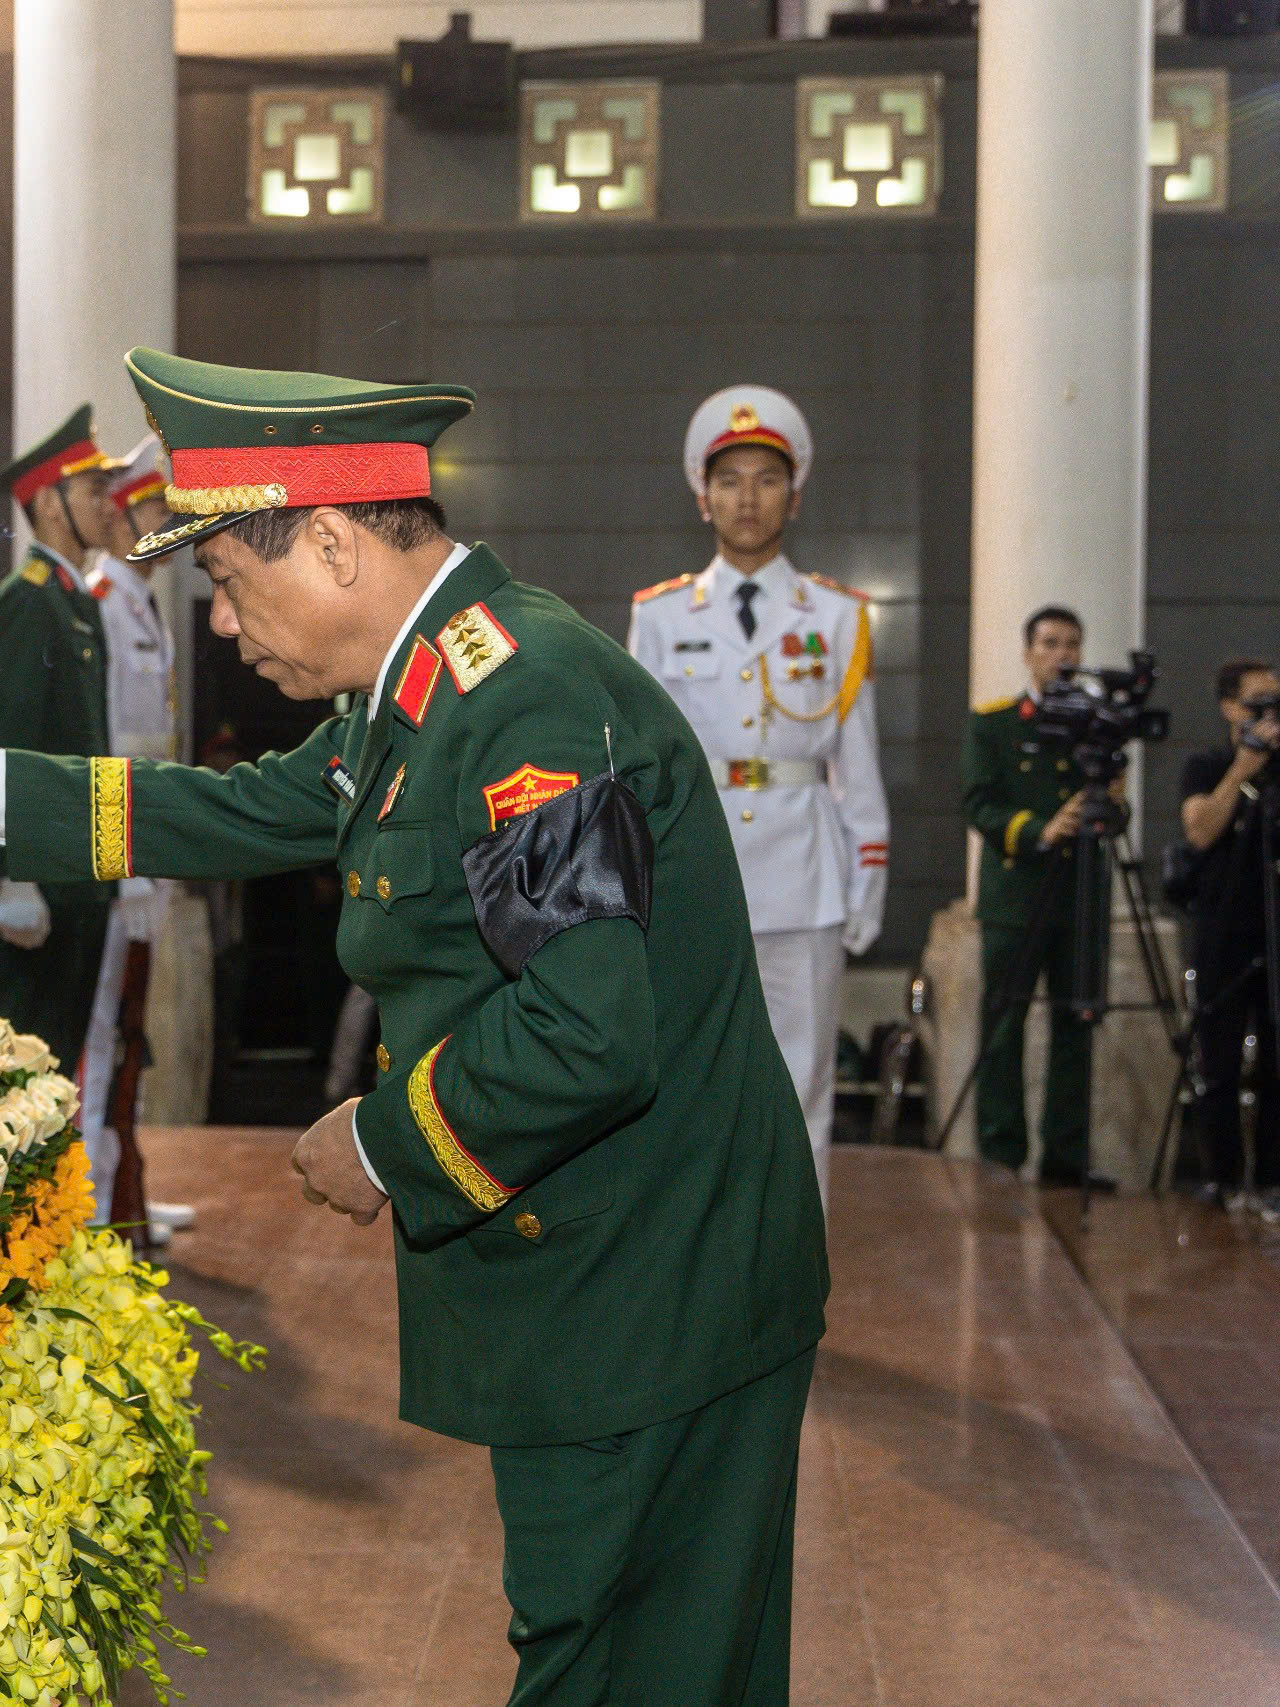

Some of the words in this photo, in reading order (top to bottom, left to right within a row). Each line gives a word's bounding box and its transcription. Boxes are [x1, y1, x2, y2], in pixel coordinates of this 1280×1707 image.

[496, 797, 515, 809] QUÂN
[515, 792, 528, 804] ĐỘI
[530, 788, 552, 801] NHÂN
